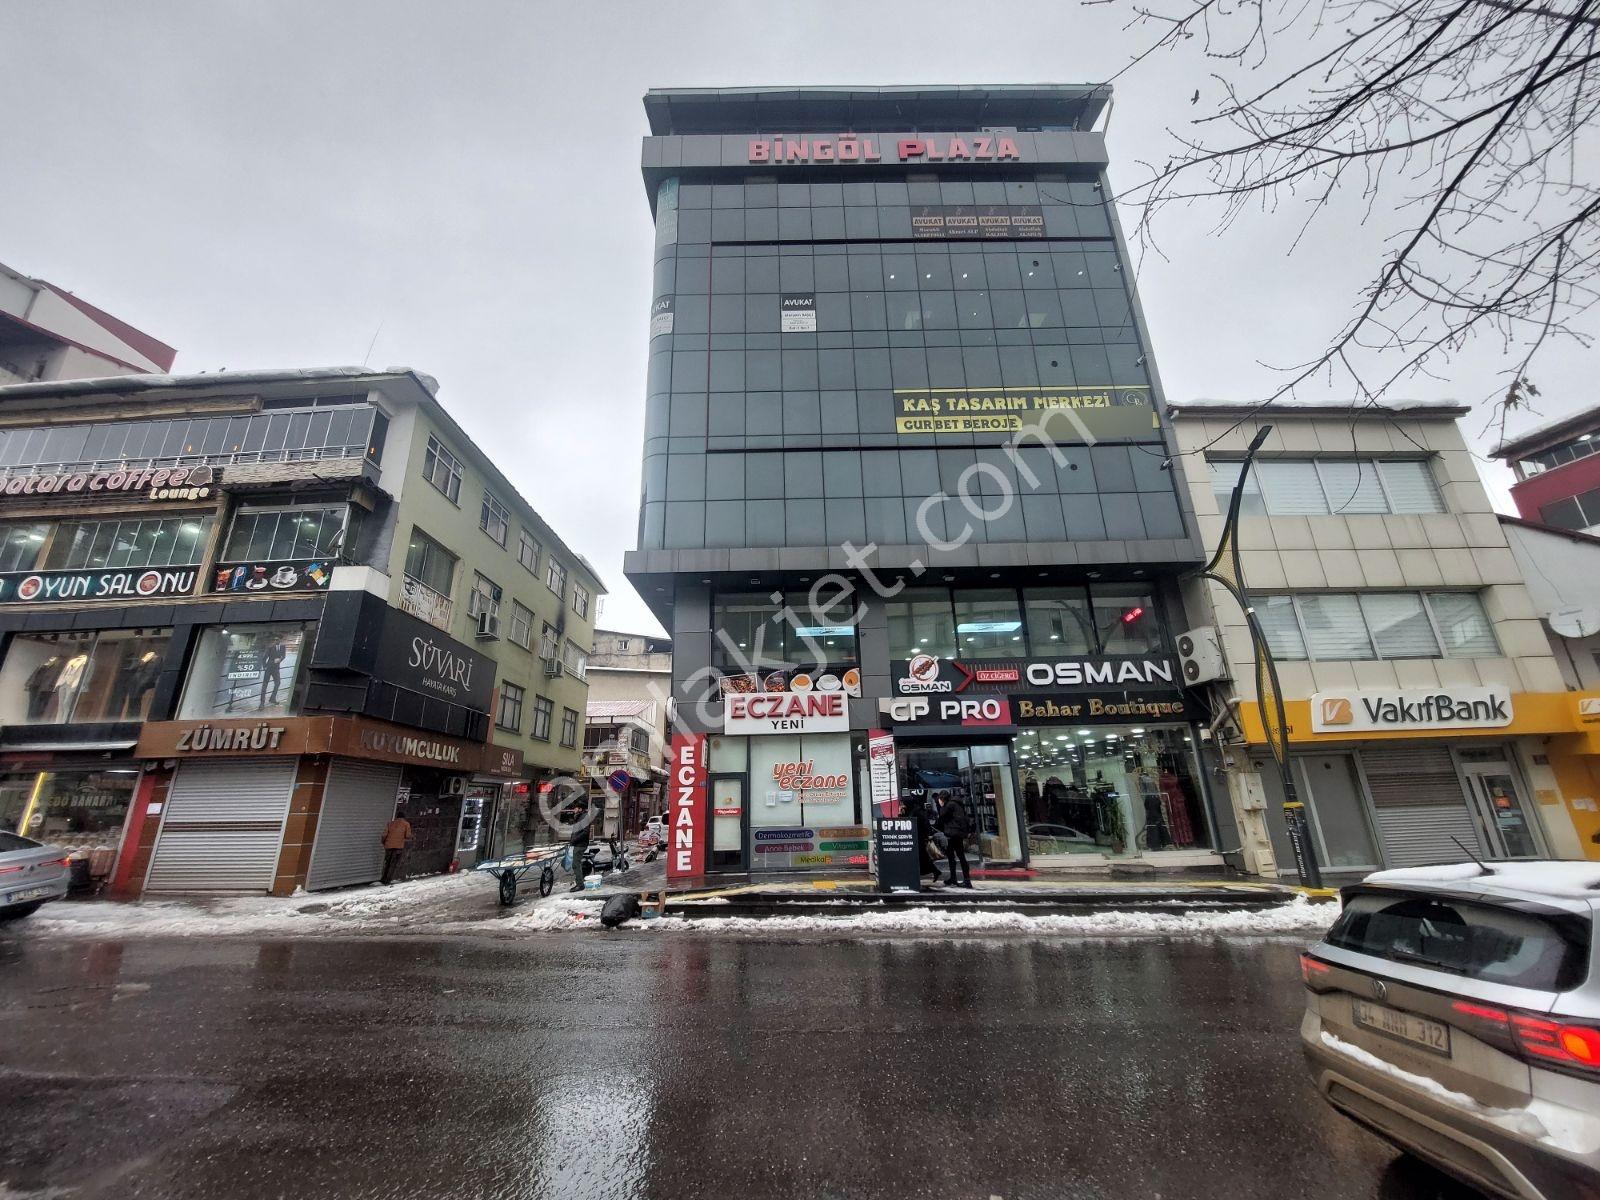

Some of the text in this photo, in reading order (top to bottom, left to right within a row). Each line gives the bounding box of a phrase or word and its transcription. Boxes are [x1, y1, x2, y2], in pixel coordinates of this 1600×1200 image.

[749, 133, 1020, 163] BİNGÖL PLAZA
[903, 392, 1112, 415] KAŞ TASARIM MERKEZİ
[903, 417, 1018, 431] GURBET BEROJE
[90, 468, 189, 492] coffee
[150, 487, 210, 500] Lounge
[18, 575, 92, 600] OYUN
[96, 570, 195, 597] SALONU
[1027, 660, 1173, 686] OSMAN
[901, 682, 950, 692] OSMAN
[730, 694, 844, 720] ECZANE
[890, 698, 1001, 722] CP PRO
[1019, 697, 1185, 718] Bahar Boutique
[1362, 694, 1508, 724] VakıfBank
[771, 717, 804, 731] YENİ
[175, 722, 286, 751] ZÜMRÜT
[360, 728, 460, 763] KUYUMCULUK
[772, 759, 815, 781] yeni
[779, 773, 848, 790] eczane
[675, 746, 696, 871] ECZANE
[881, 820, 912, 831] CP PRO
